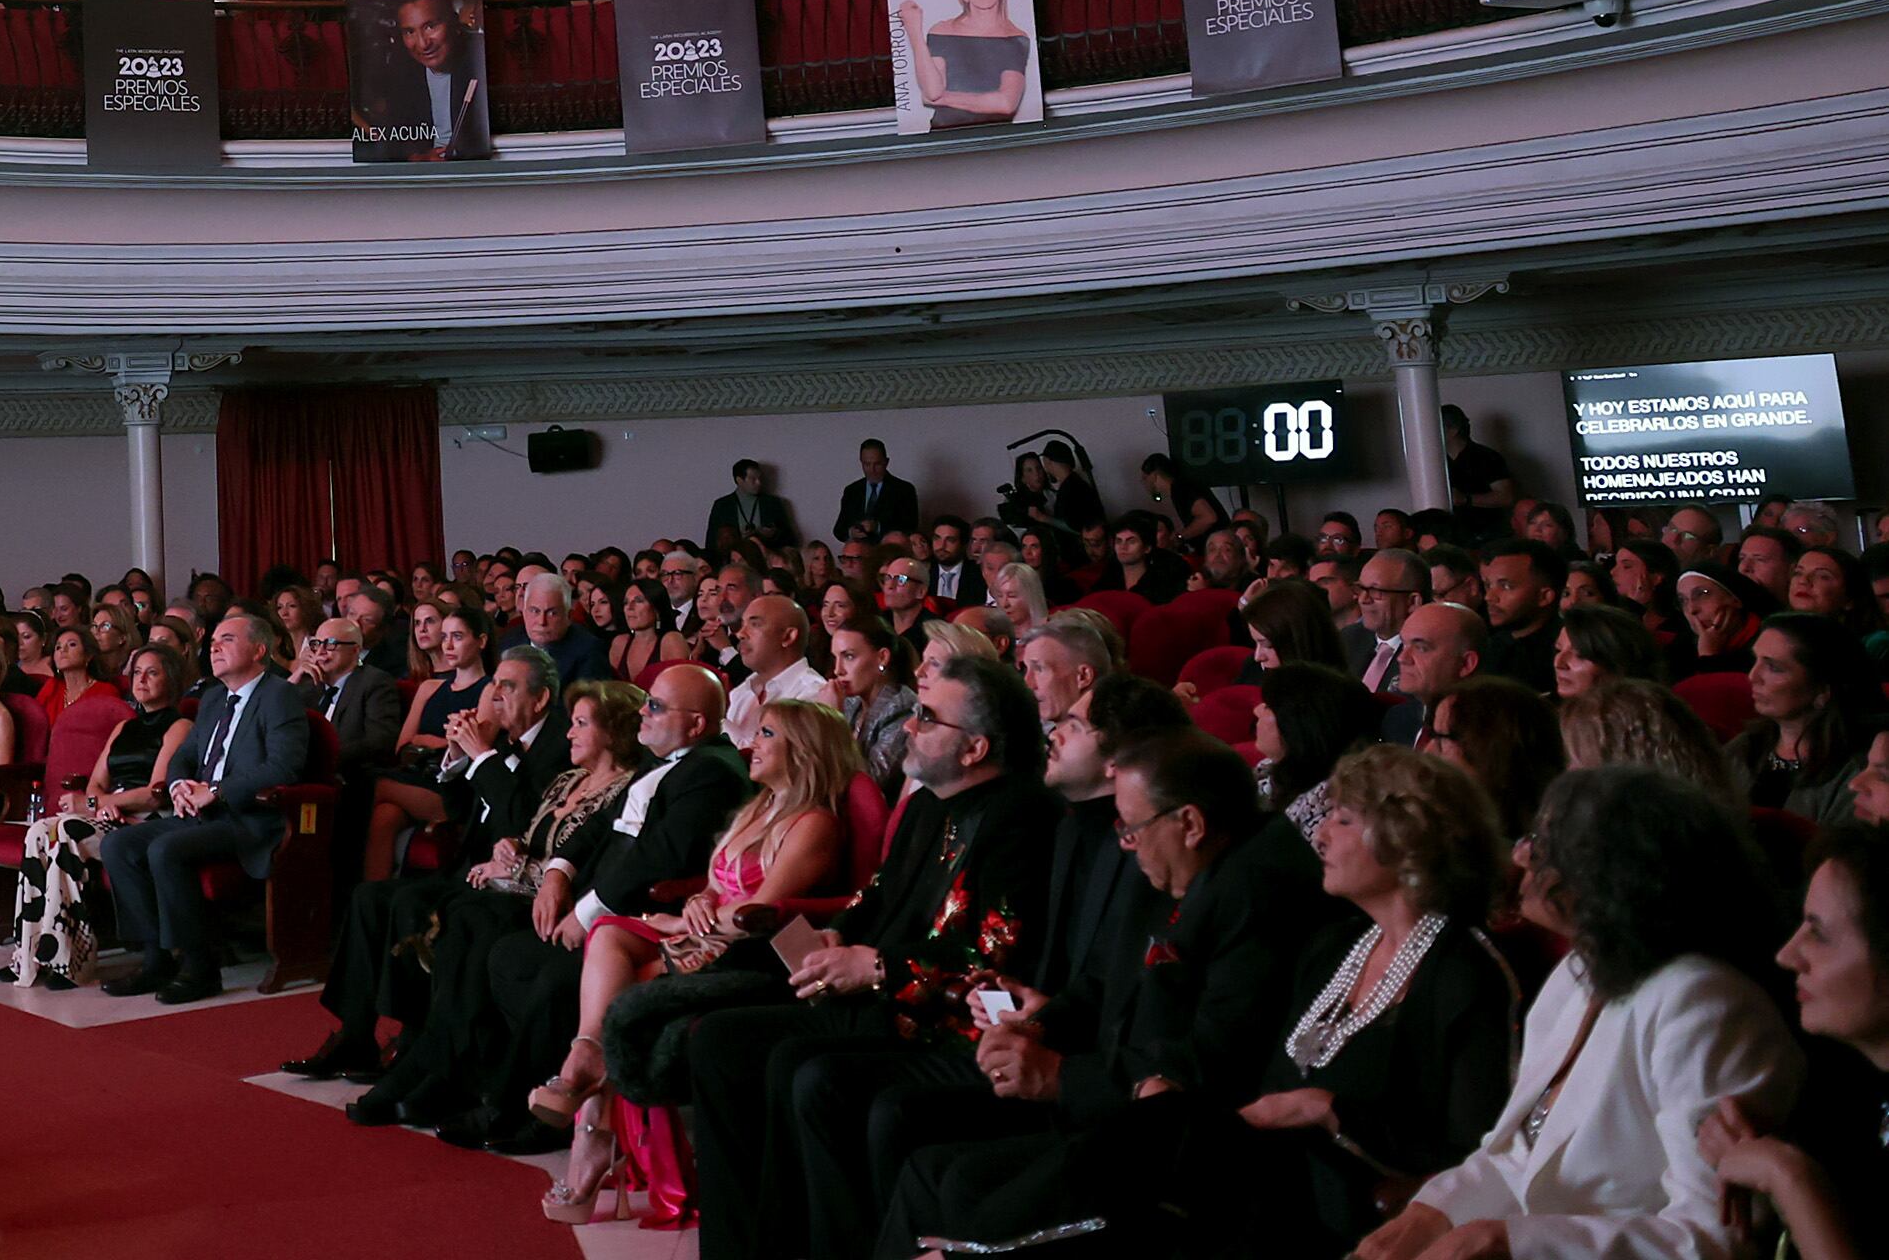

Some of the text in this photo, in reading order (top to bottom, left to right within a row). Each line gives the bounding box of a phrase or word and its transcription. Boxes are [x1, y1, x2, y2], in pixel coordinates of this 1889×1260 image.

[1206, 2, 1315, 36] ESPECIALES
[651, 60, 728, 81] PREMIOS
[889, 9, 911, 111] ANA TORROJA
[115, 79, 189, 96] PREMIOS
[640, 74, 742, 99] ESPECIALES
[103, 94, 201, 112] ESPECIALES
[352, 122, 440, 142] ALEX ACUÑA
[1573, 390, 1808, 417] Y HOY ESTAMOS AQUÍ PARA
[1575, 410, 1813, 435] CELEBRARLOS EN GRANDE.
[1580, 451, 1739, 471] TODOS NUESTROS
[1583, 468, 1766, 489] HOMENAJEADOS HAN
